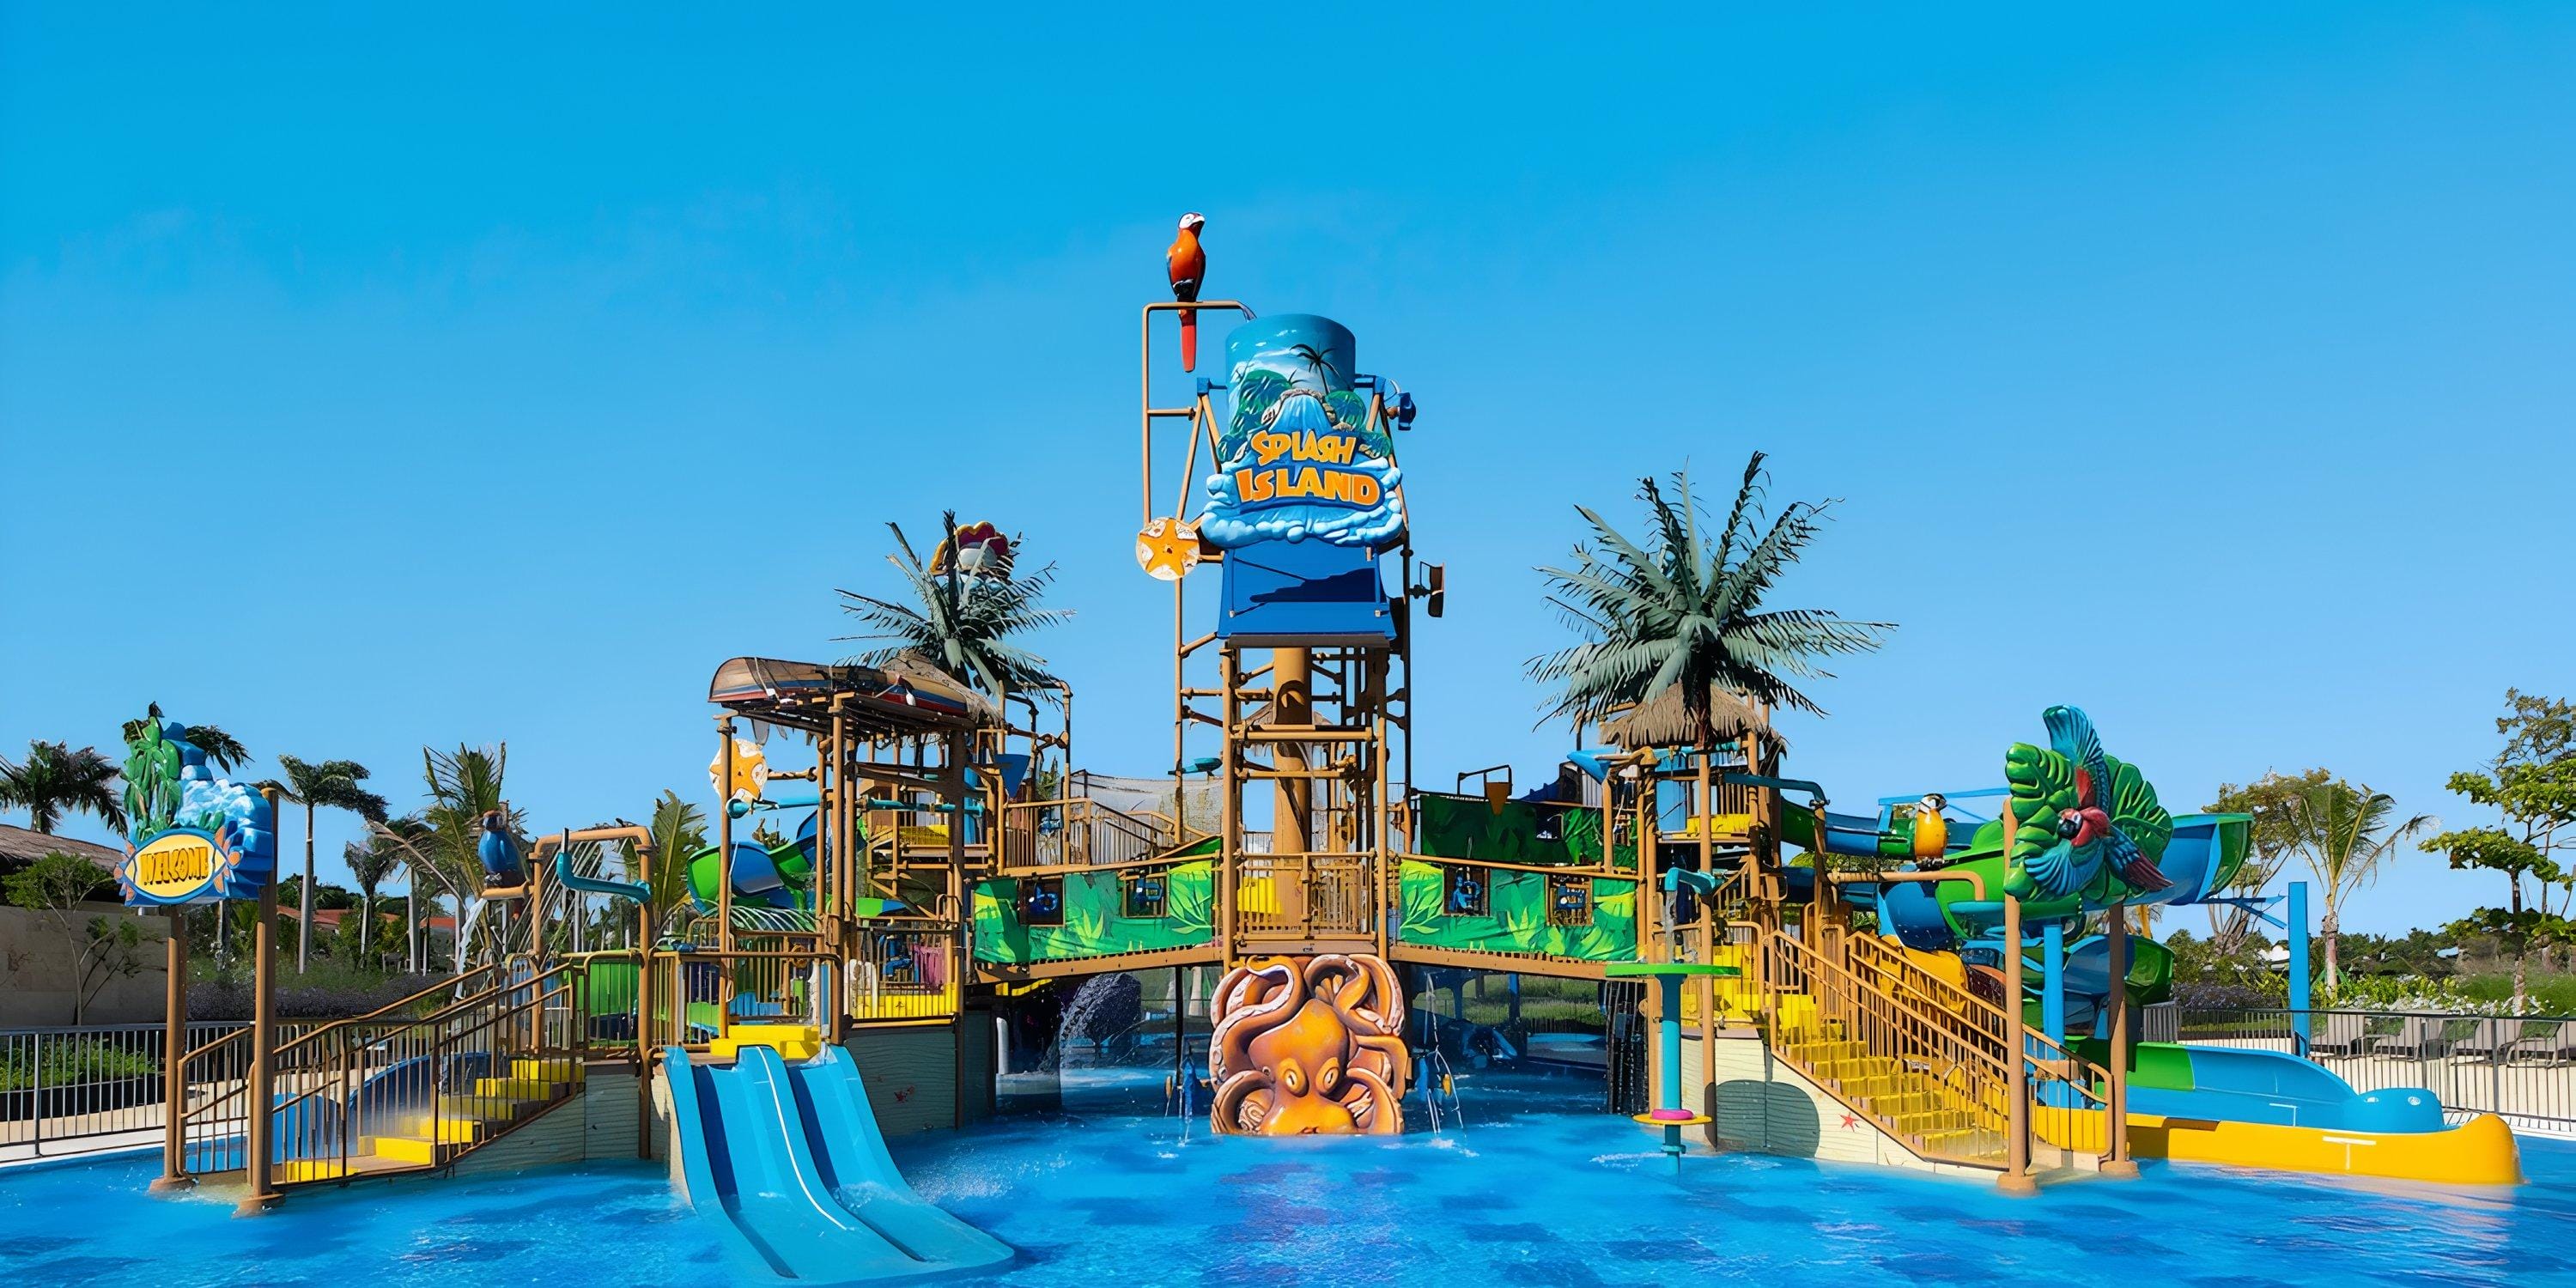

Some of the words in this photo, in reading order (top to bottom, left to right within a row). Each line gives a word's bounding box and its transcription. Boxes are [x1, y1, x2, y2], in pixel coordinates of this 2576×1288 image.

[1251, 429, 1357, 466] SPLASH
[1236, 466, 1380, 506] ISLAND
[140, 847, 209, 885] WELCOME
